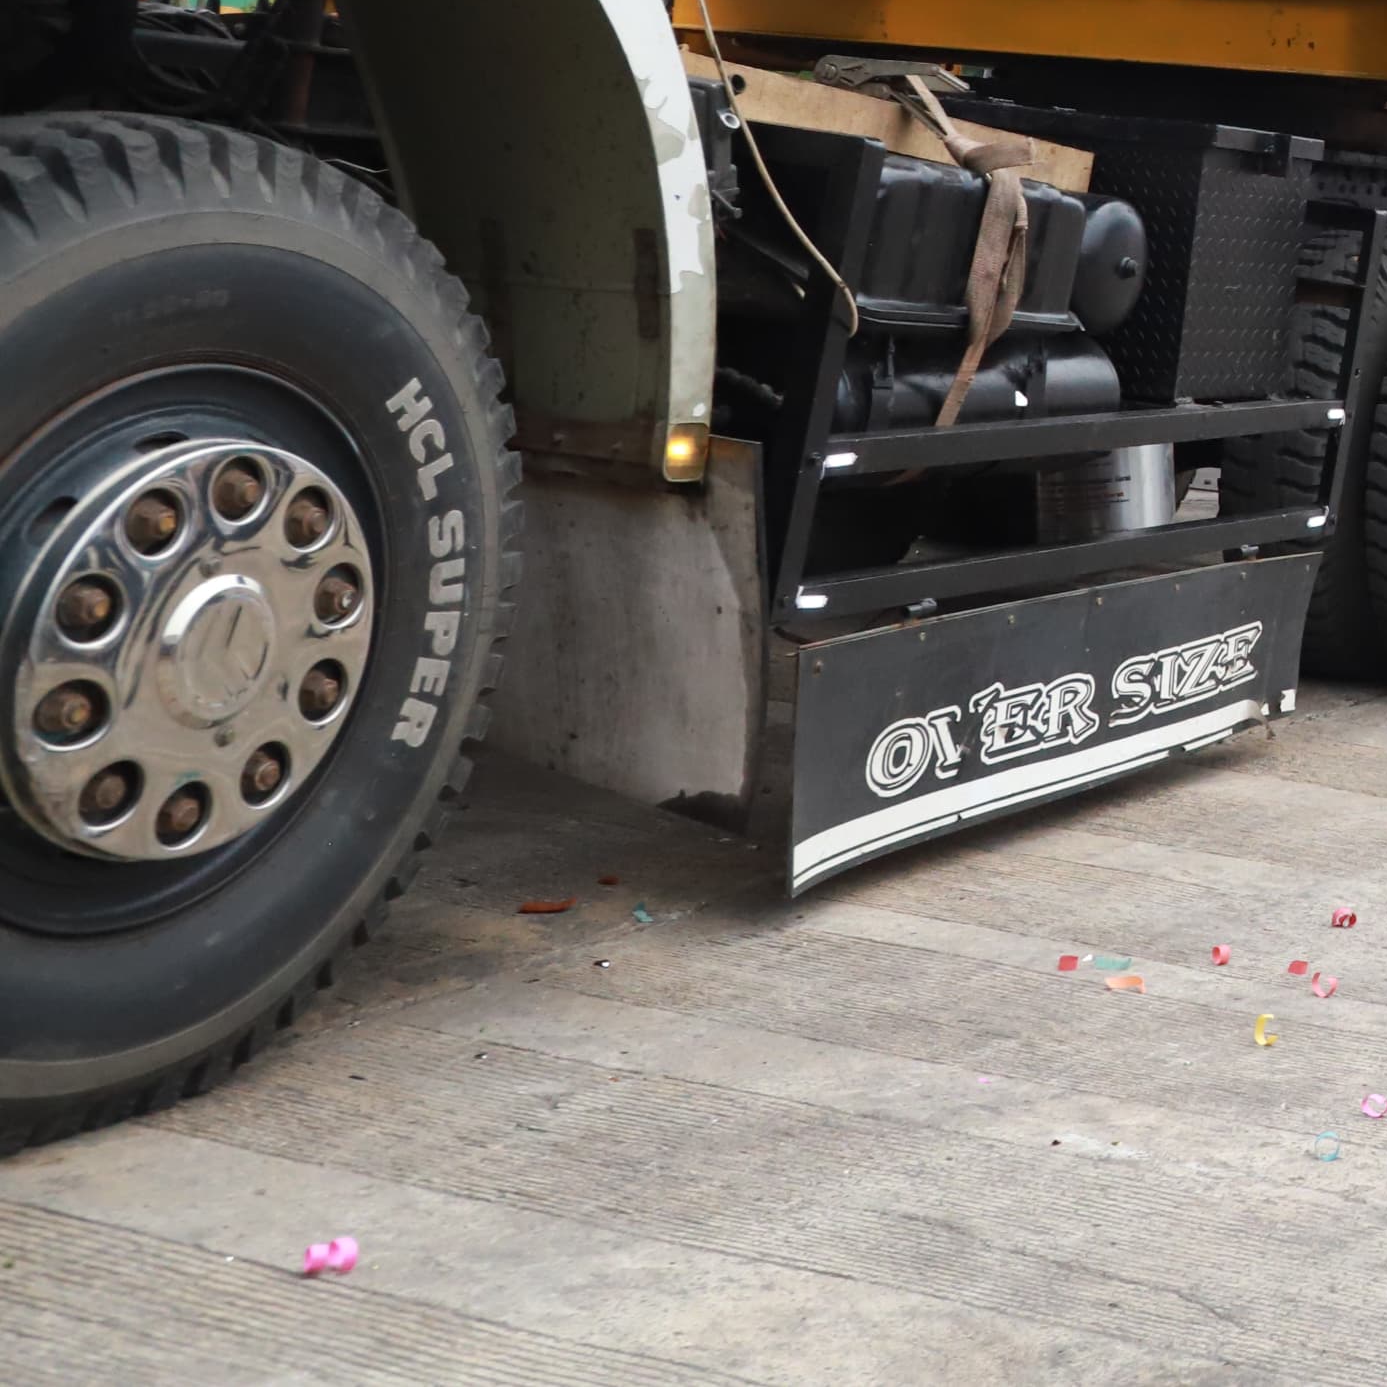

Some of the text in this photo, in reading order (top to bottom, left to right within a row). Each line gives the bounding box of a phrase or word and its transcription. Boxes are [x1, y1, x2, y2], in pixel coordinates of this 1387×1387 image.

[389, 509, 466, 749] SUPER
[864, 619, 1263, 798] OVER SIZE
